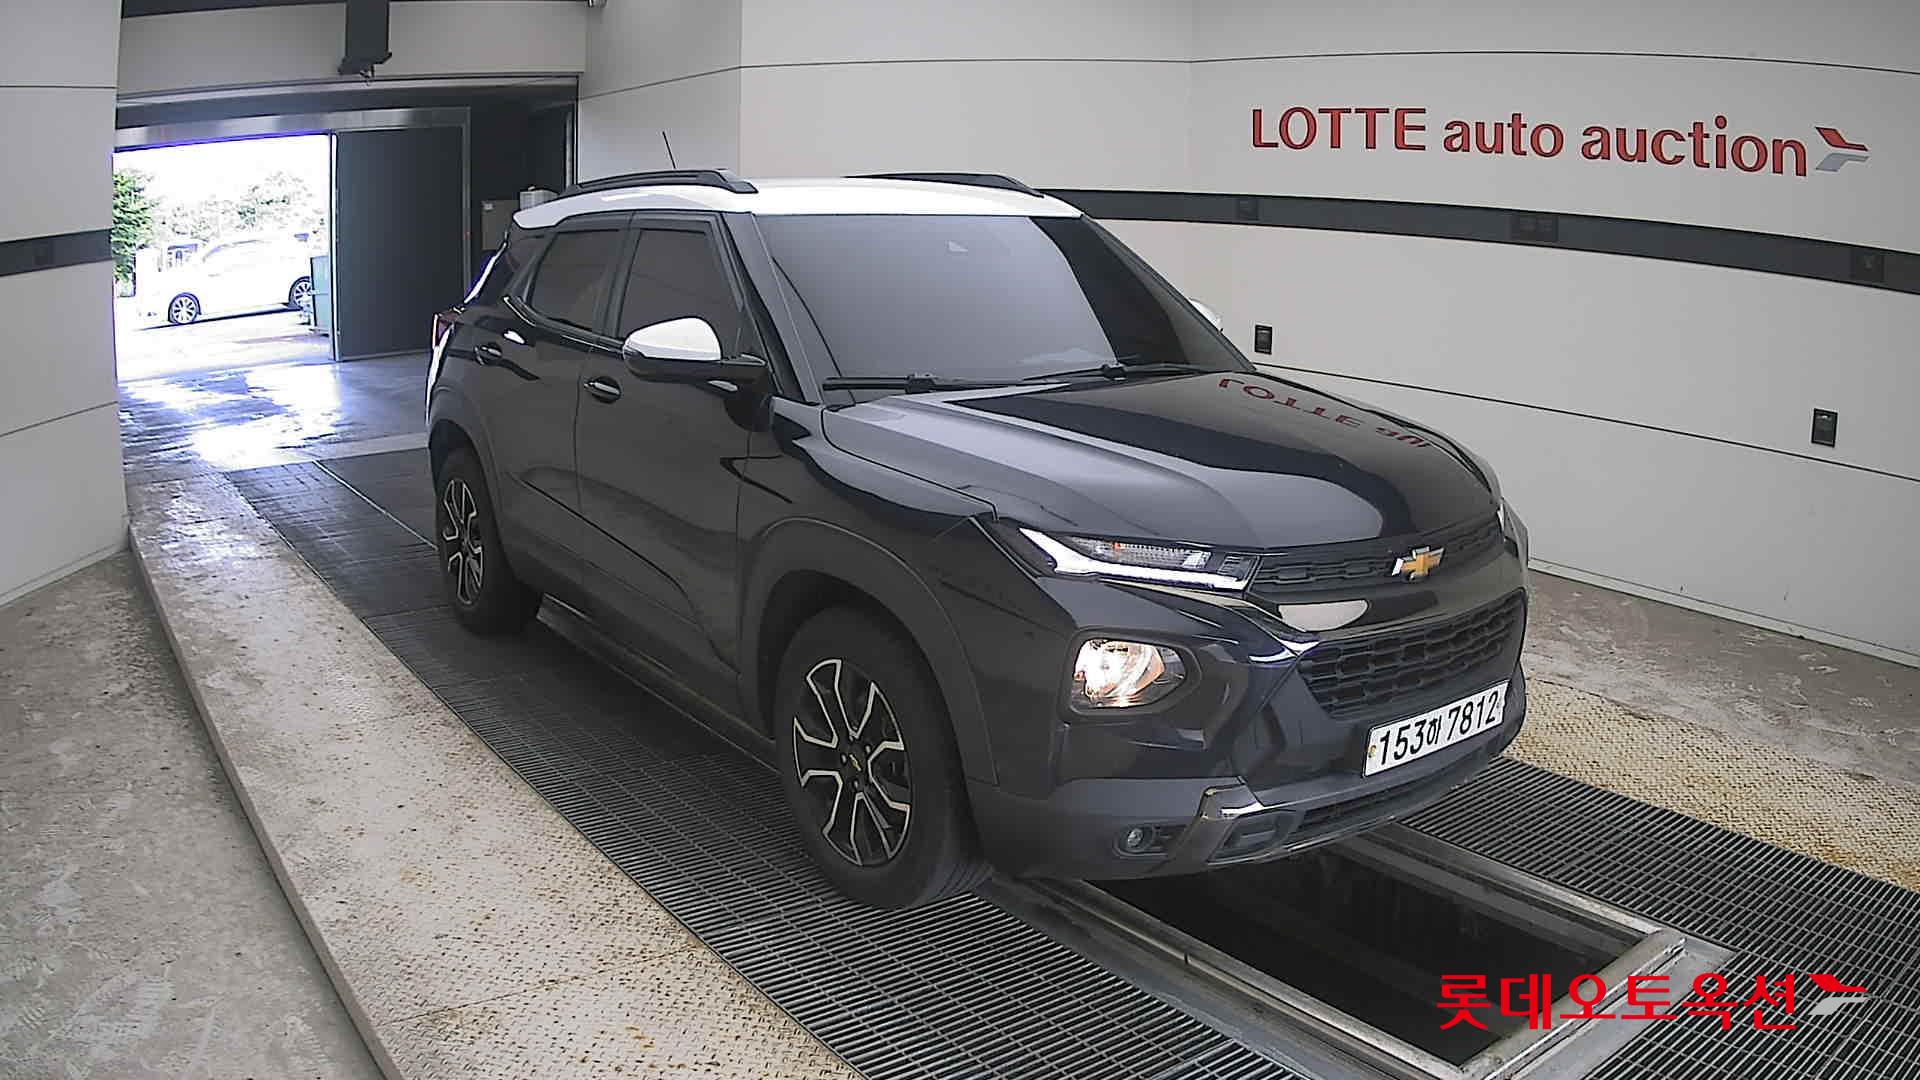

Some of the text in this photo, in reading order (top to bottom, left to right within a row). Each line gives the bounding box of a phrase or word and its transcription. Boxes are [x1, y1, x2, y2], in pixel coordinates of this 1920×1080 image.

[1252, 107, 1807, 177] LOTTE auto auction
[1447, 690, 1499, 741] 7812
